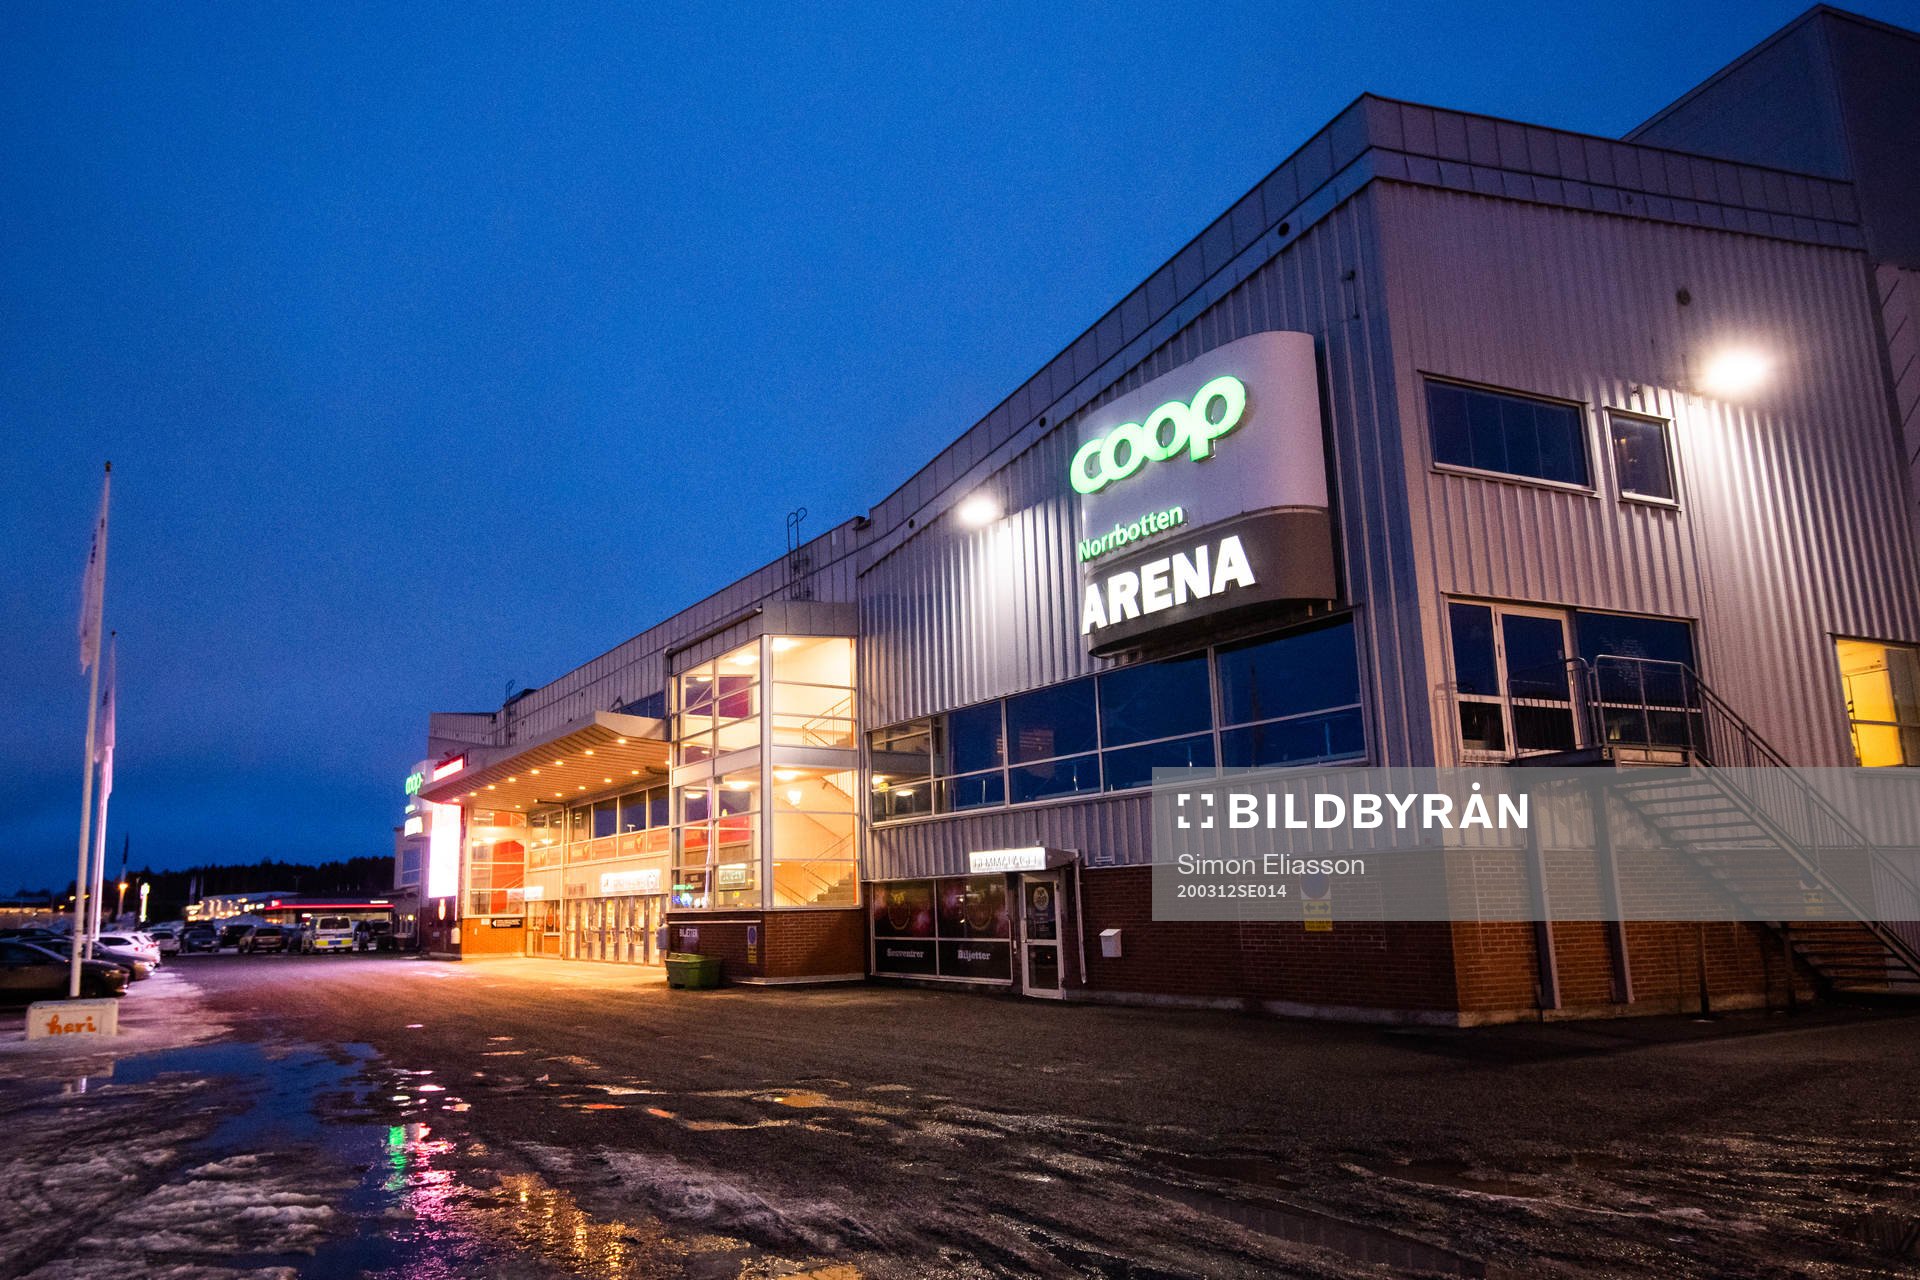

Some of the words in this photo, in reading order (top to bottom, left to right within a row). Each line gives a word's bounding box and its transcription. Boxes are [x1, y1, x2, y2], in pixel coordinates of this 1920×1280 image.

[1070, 375, 1246, 494] coop
[1078, 506, 1184, 562] Norrbotten
[1081, 535, 1256, 635] ARENA
[957, 949, 991, 962] Biljetter
